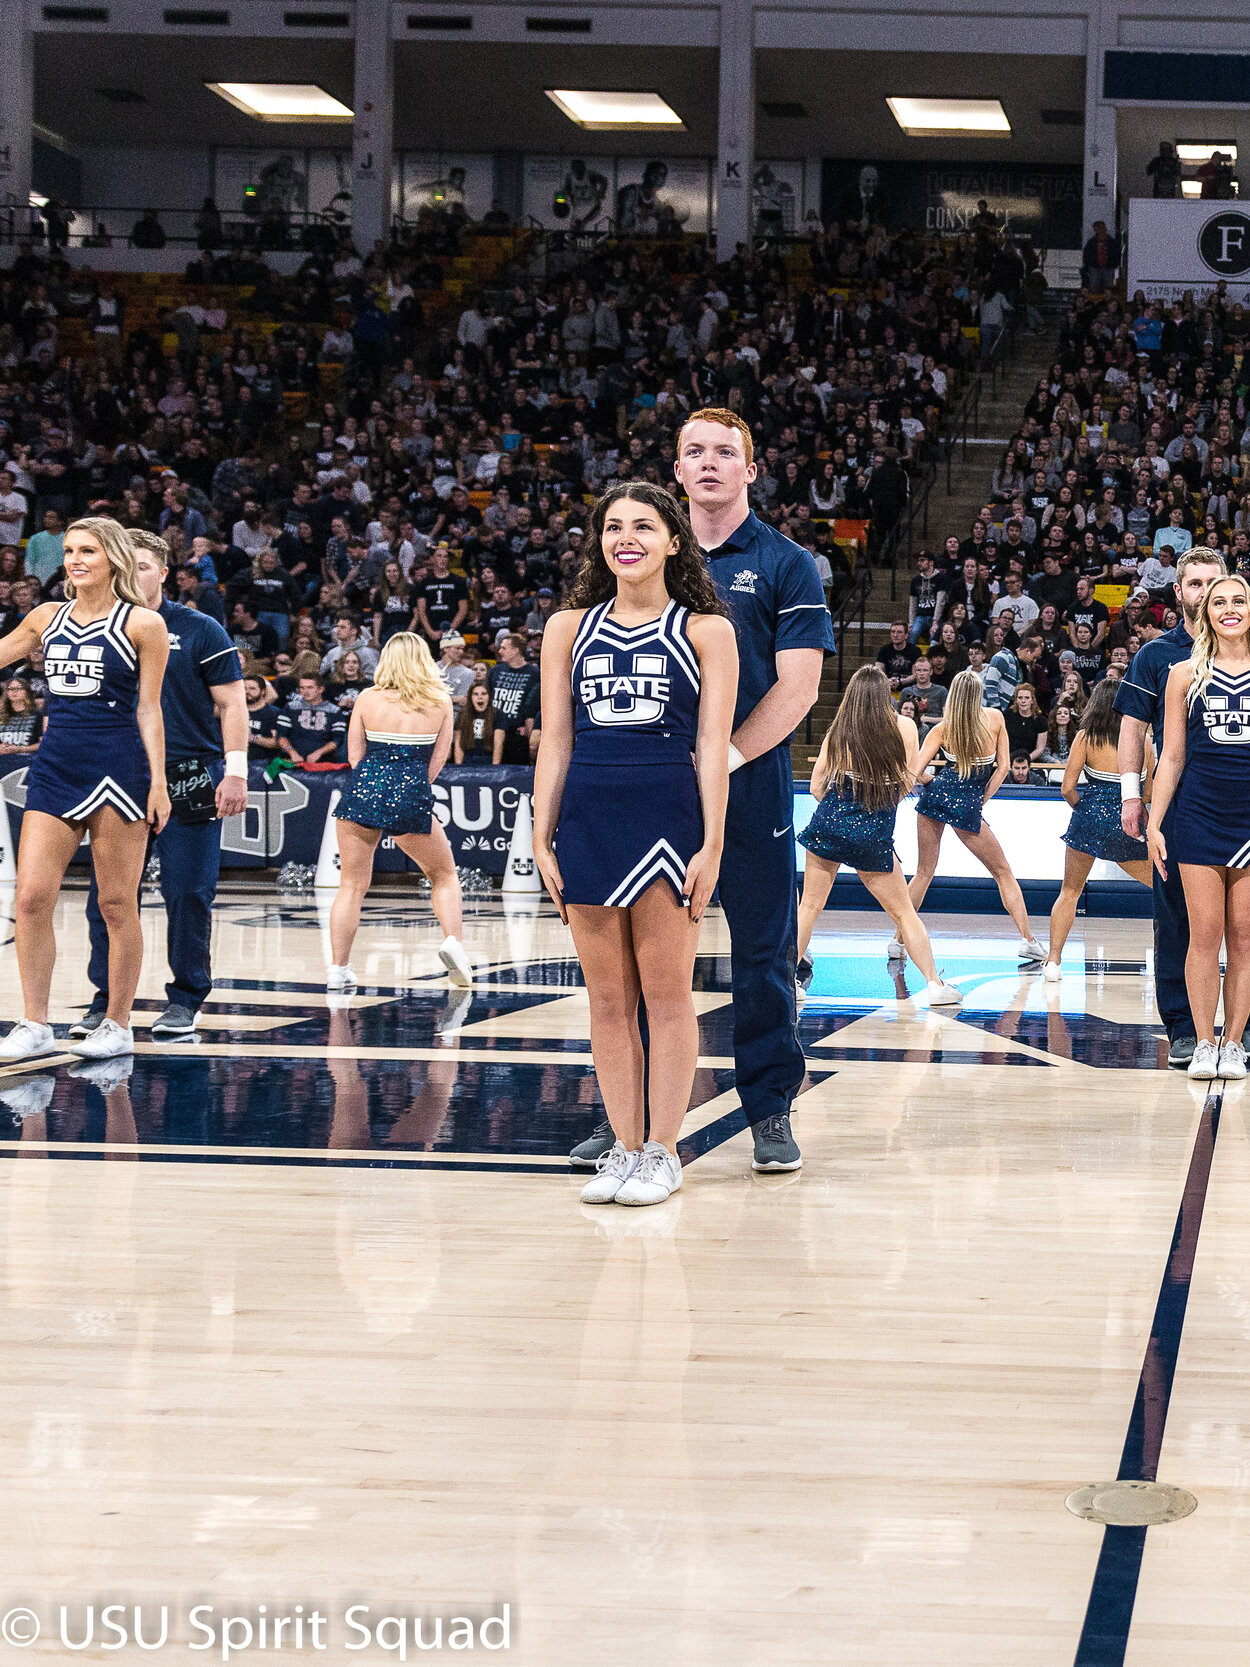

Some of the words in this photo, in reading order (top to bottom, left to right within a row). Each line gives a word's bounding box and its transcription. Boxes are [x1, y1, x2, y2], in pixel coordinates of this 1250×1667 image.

[361, 154, 373, 169] J
[726, 161, 741, 178] K
[1094, 171, 1105, 187] L
[1216, 225, 1245, 262] F
[1146, 286, 1170, 296] 2175
[1173, 286, 1199, 297] Noth
[44, 660, 104, 680] STATE
[494, 687, 524, 703] TRUE
[579, 676, 671, 704] STATE
[431, 784, 494, 832] SU
